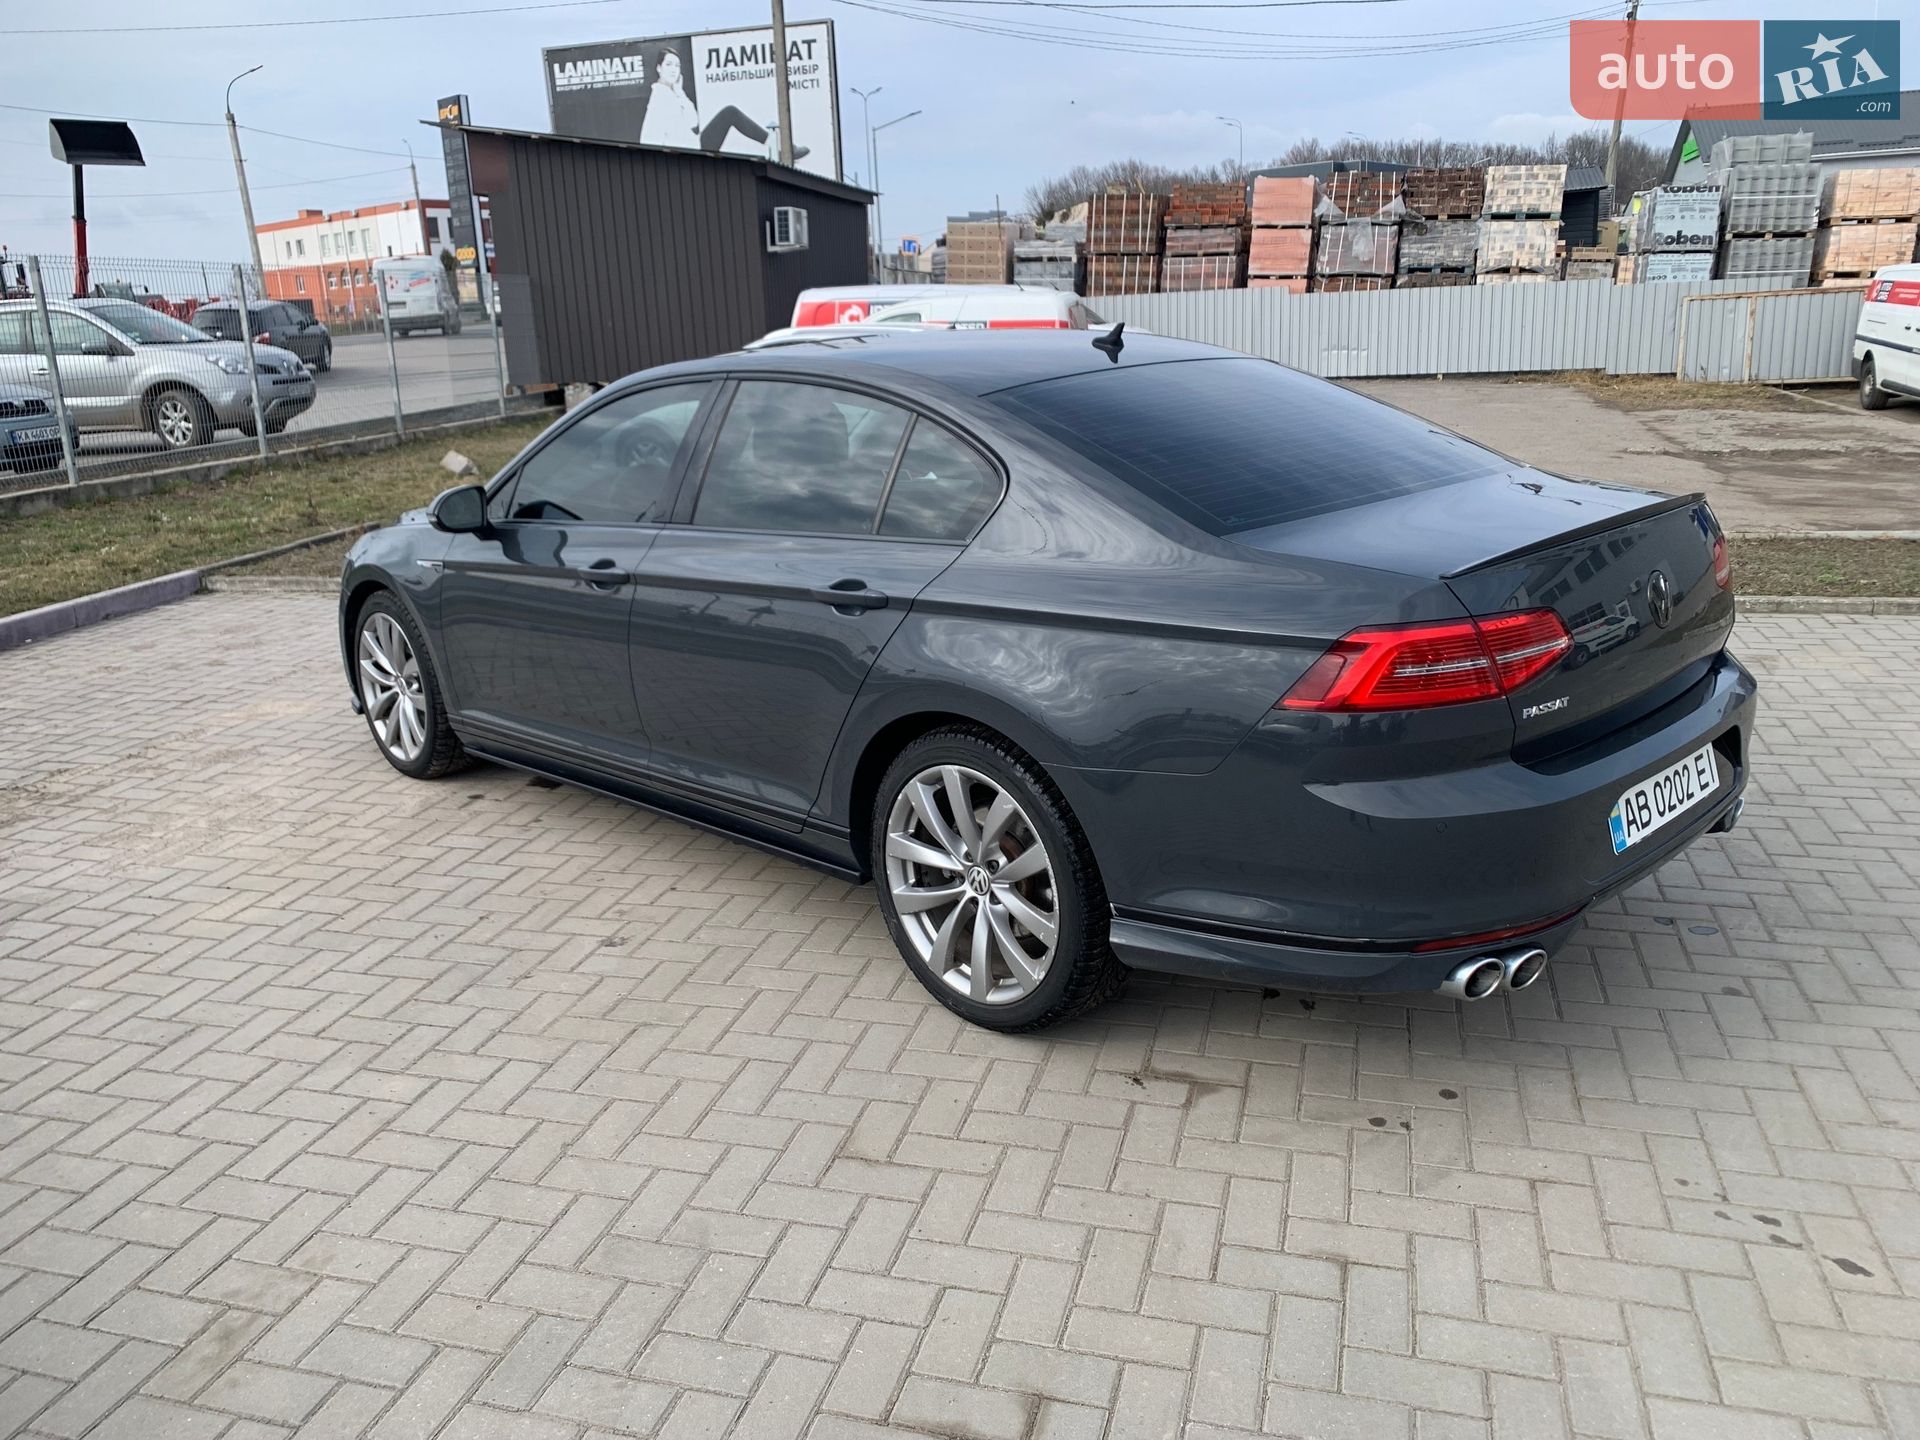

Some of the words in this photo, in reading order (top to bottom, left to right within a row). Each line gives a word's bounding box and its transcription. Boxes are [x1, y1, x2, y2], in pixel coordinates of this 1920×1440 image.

[553, 55, 644, 79] LAMINATE
[706, 68, 774, 83] НАЙБІЛЬШИ
[1522, 696, 1570, 719] PASSAT
[1624, 789, 1652, 838] AB
[1653, 763, 1695, 818] 0202
[1694, 748, 1715, 792] EI
